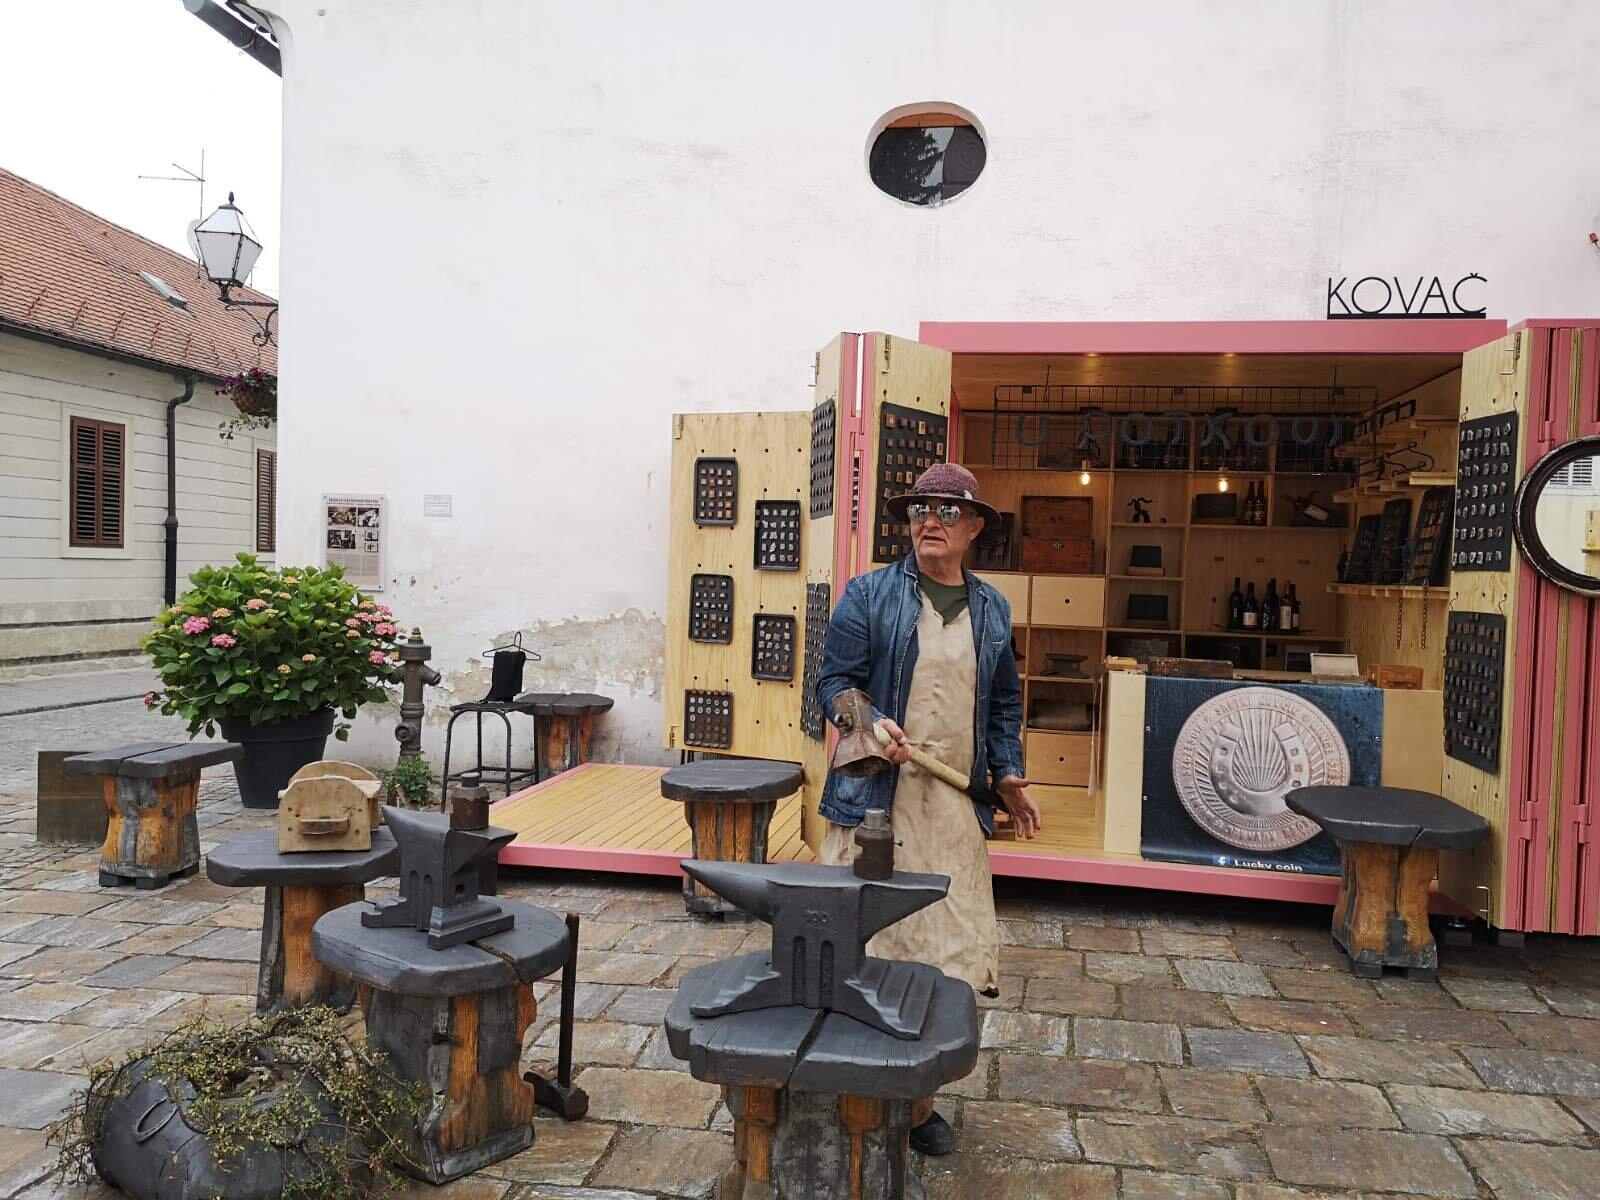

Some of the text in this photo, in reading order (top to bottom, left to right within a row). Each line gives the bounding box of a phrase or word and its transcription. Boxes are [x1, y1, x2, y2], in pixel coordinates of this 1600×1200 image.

[1327, 273, 1487, 314] KOVAČ
[1234, 859, 1272, 869] Lucky
[1276, 863, 1303, 872] coin
